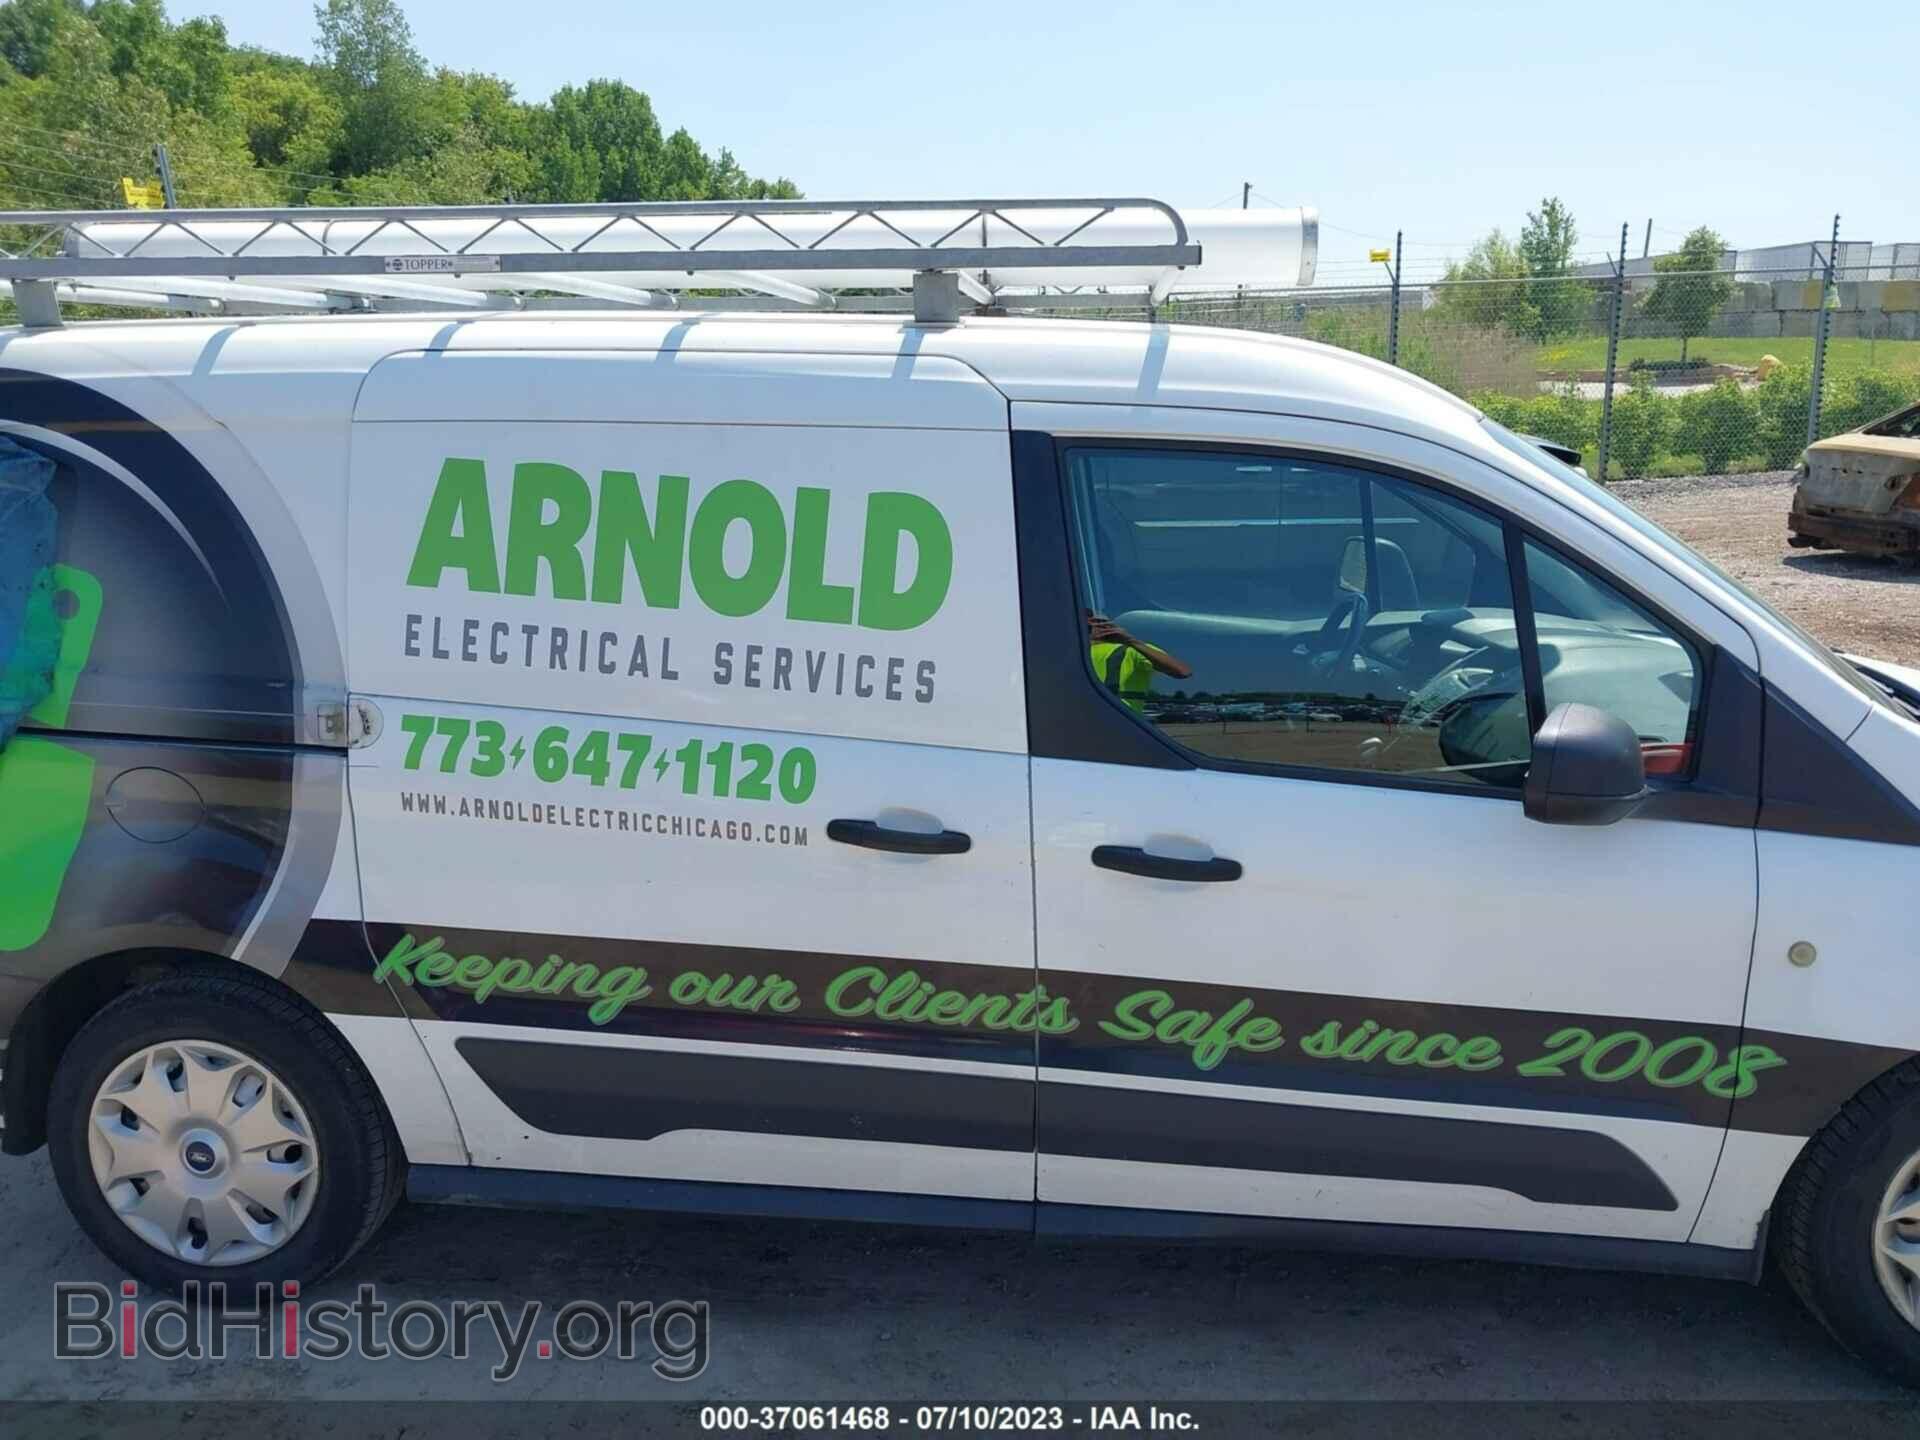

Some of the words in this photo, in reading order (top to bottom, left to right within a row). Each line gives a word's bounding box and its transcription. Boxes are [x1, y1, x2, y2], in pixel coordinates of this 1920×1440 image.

[404, 258, 448, 271] TOPPER
[407, 458, 953, 631] ARNOLD
[404, 613, 680, 681] ELECTRICAL
[713, 642, 936, 704] SERVICES
[400, 791, 809, 846] WWW.ARNOLDELECTRICCHICAGO.COM
[373, 933, 653, 1026] Keeping
[668, 970, 801, 1017] our
[823, 966, 1080, 1035] Clients
[1097, 988, 1283, 1072] Safe
[1300, 1018, 1505, 1071] since
[1517, 1028, 1788, 1099] 2008
